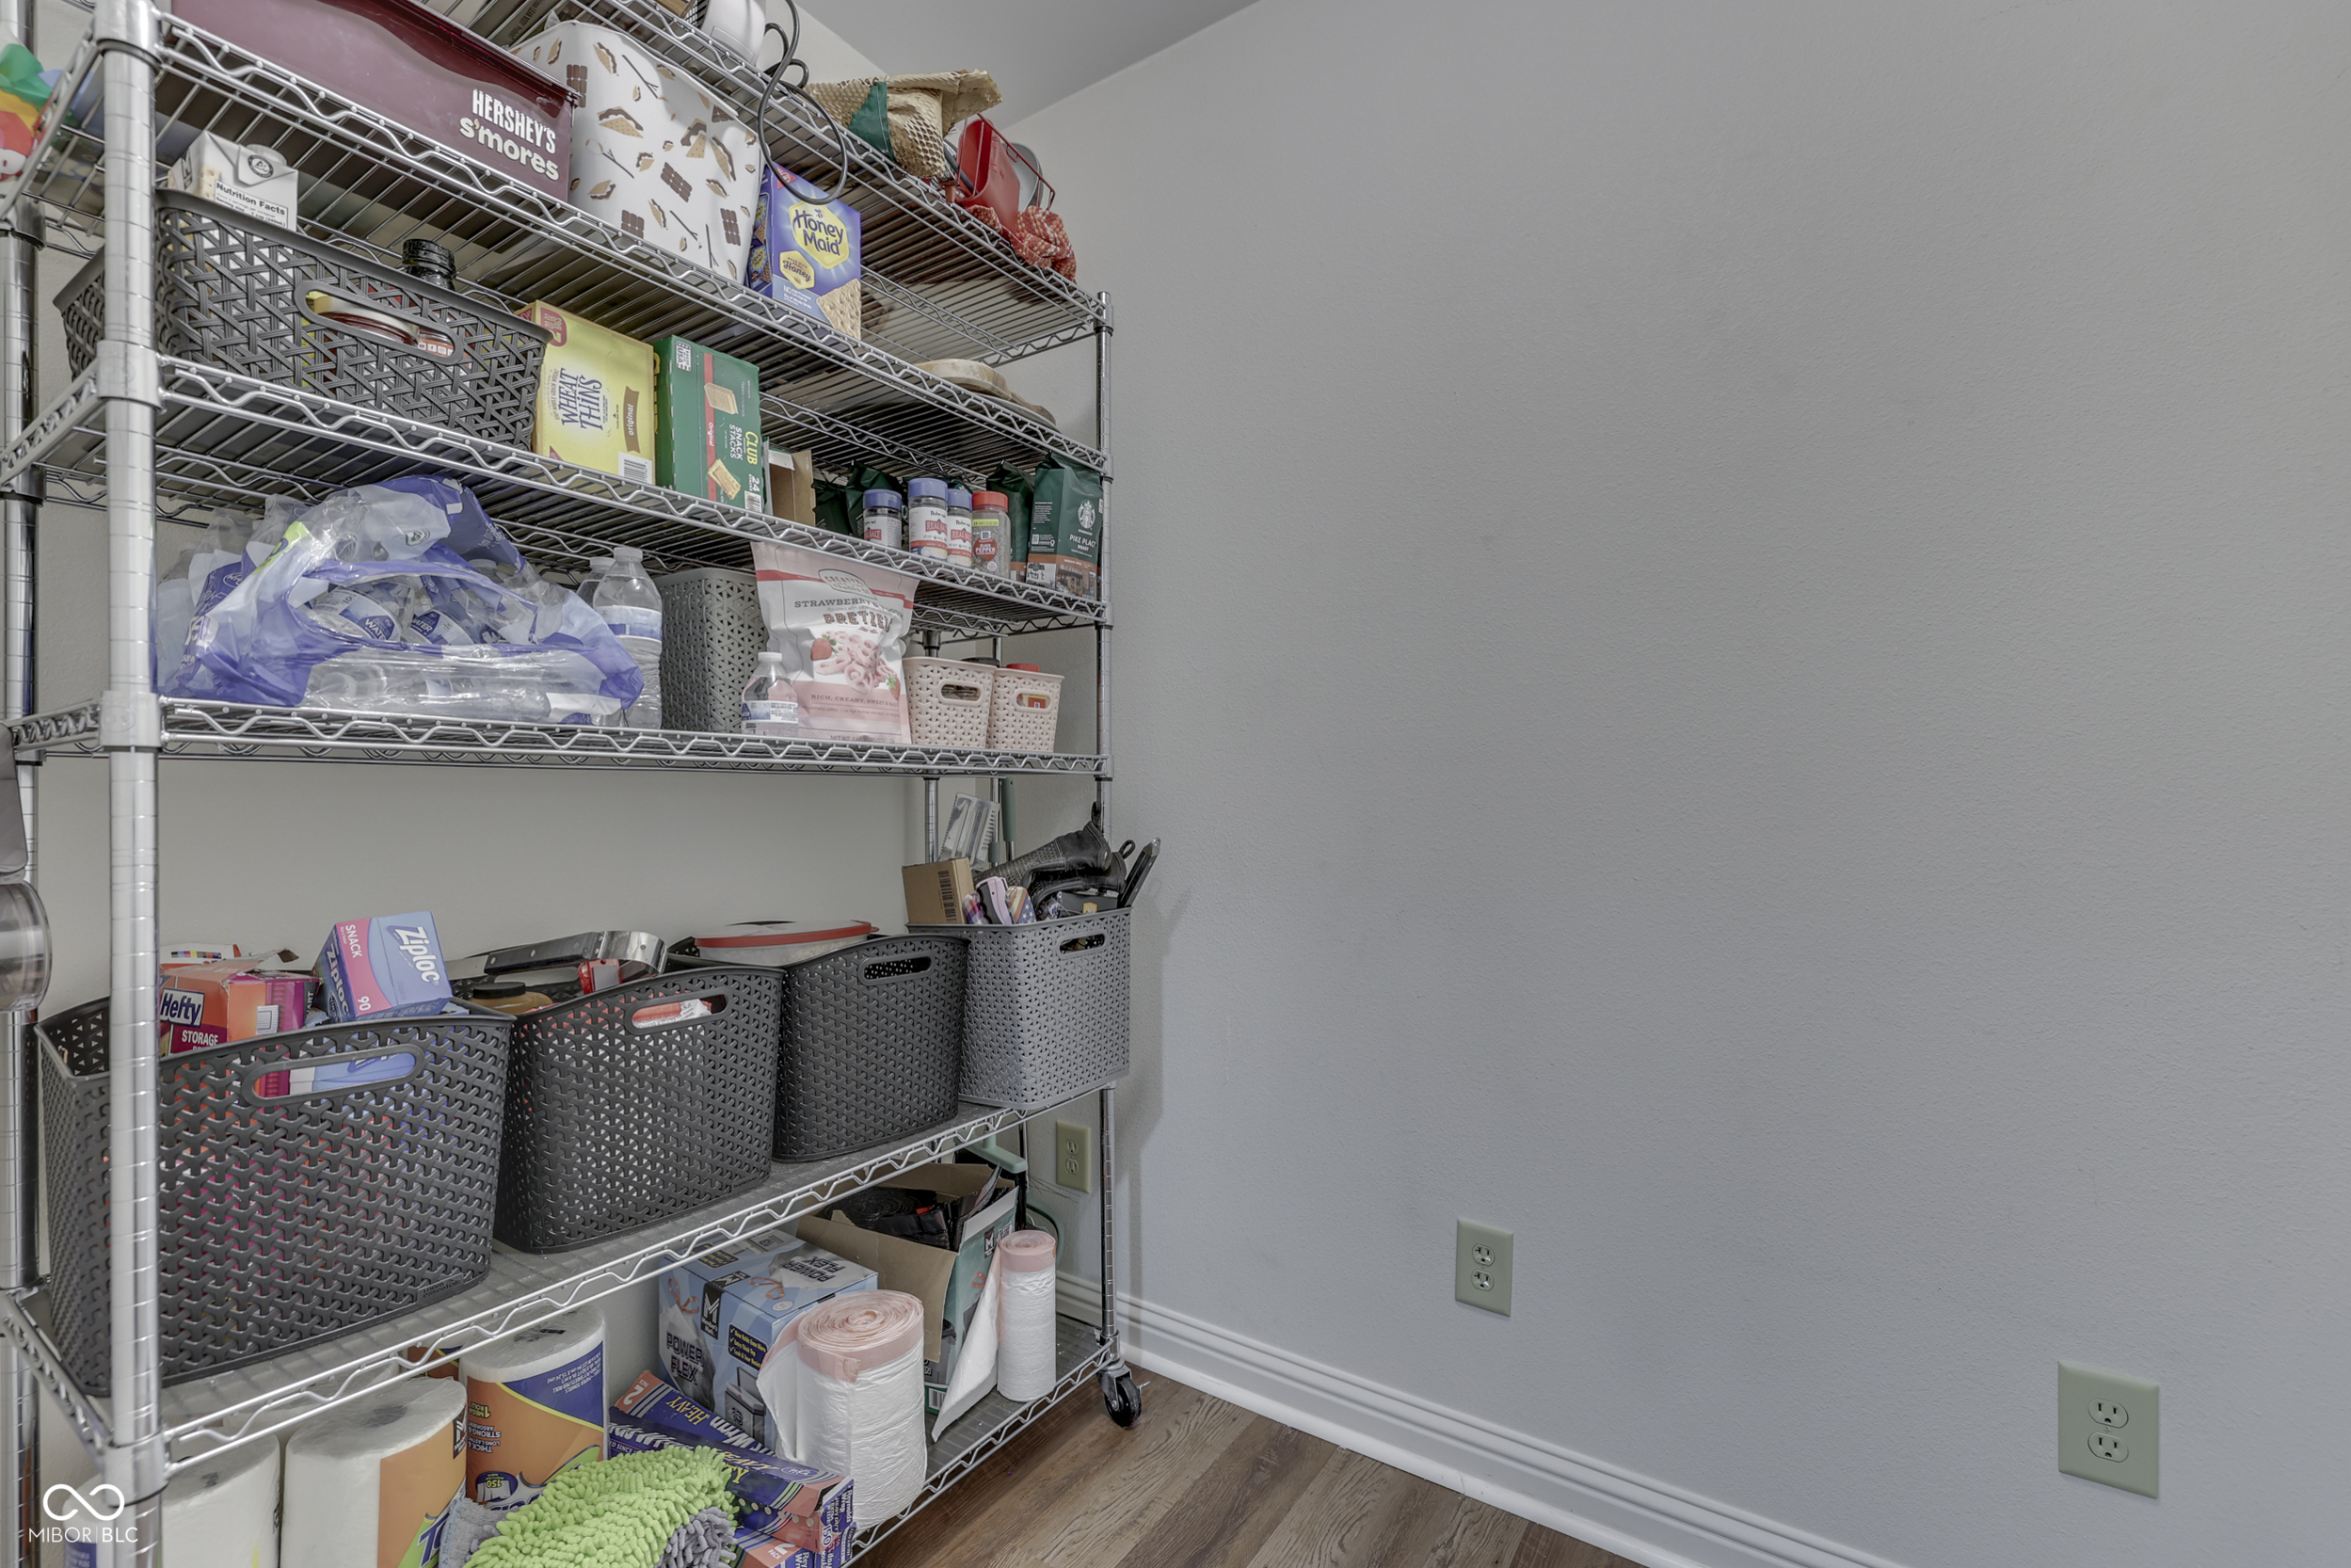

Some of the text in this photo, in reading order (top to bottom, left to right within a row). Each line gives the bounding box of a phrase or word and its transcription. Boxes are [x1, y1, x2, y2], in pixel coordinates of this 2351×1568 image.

[472, 88, 556, 154] HERSHEY'S
[459, 117, 560, 181] s'mores
[216, 182, 257, 206] Nutrition
[259, 200, 286, 216] Facts
[792, 209, 843, 245] Honey
[803, 229, 840, 256] Maid
[782, 260, 812, 283] Honey
[558, 367, 579, 426] WHEAT
[706, 422, 714, 447] Original
[728, 424, 737, 459] STACKS
[735, 425, 744, 461] SNACK
[744, 430, 759, 466] CLUB
[752, 474, 760, 493] 24
[926, 520, 940, 532] REAL
[952, 530, 965, 540] REAL
[1069, 534, 1081, 544] PIKE
[1077, 543, 1090, 552] ROAST
[793, 598, 871, 608] STRAWBERRY
[364, 617, 386, 641] WATE
[823, 611, 893, 633] PRETZEL
[834, 696, 866, 704] CREAMY,
[344, 923, 363, 959] SNACK
[394, 925, 440, 984] Ziploc
[326, 942, 350, 1016] Ziploc
[160, 992, 201, 1026] Hefty
[357, 996, 372, 1012] 90
[181, 1030, 219, 1046] STORAGE
[781, 1260, 837, 1283] POWER
[806, 1256, 846, 1273] FLEX
[666, 1331, 703, 1365] POWER
[671, 1355, 697, 1385] FLEX
[639, 1379, 649, 1388] PACK
[623, 1384, 645, 1406] 2
[470, 1405, 491, 1418] 1 MEGA
[471, 1402, 485, 1411] ROLL
[666, 1396, 711, 1425] HEAVY
[468, 1421, 494, 1431] ABSORBEN
[472, 1428, 502, 1438] STRONG
[468, 1435, 488, 1446] LASTIN
[473, 1443, 493, 1453] THICK
[616, 1442, 633, 1454] SINCE
[486, 1480, 502, 1489] 150
[821, 1524, 833, 1546] 150
[767, 1549, 781, 1560] PACK
